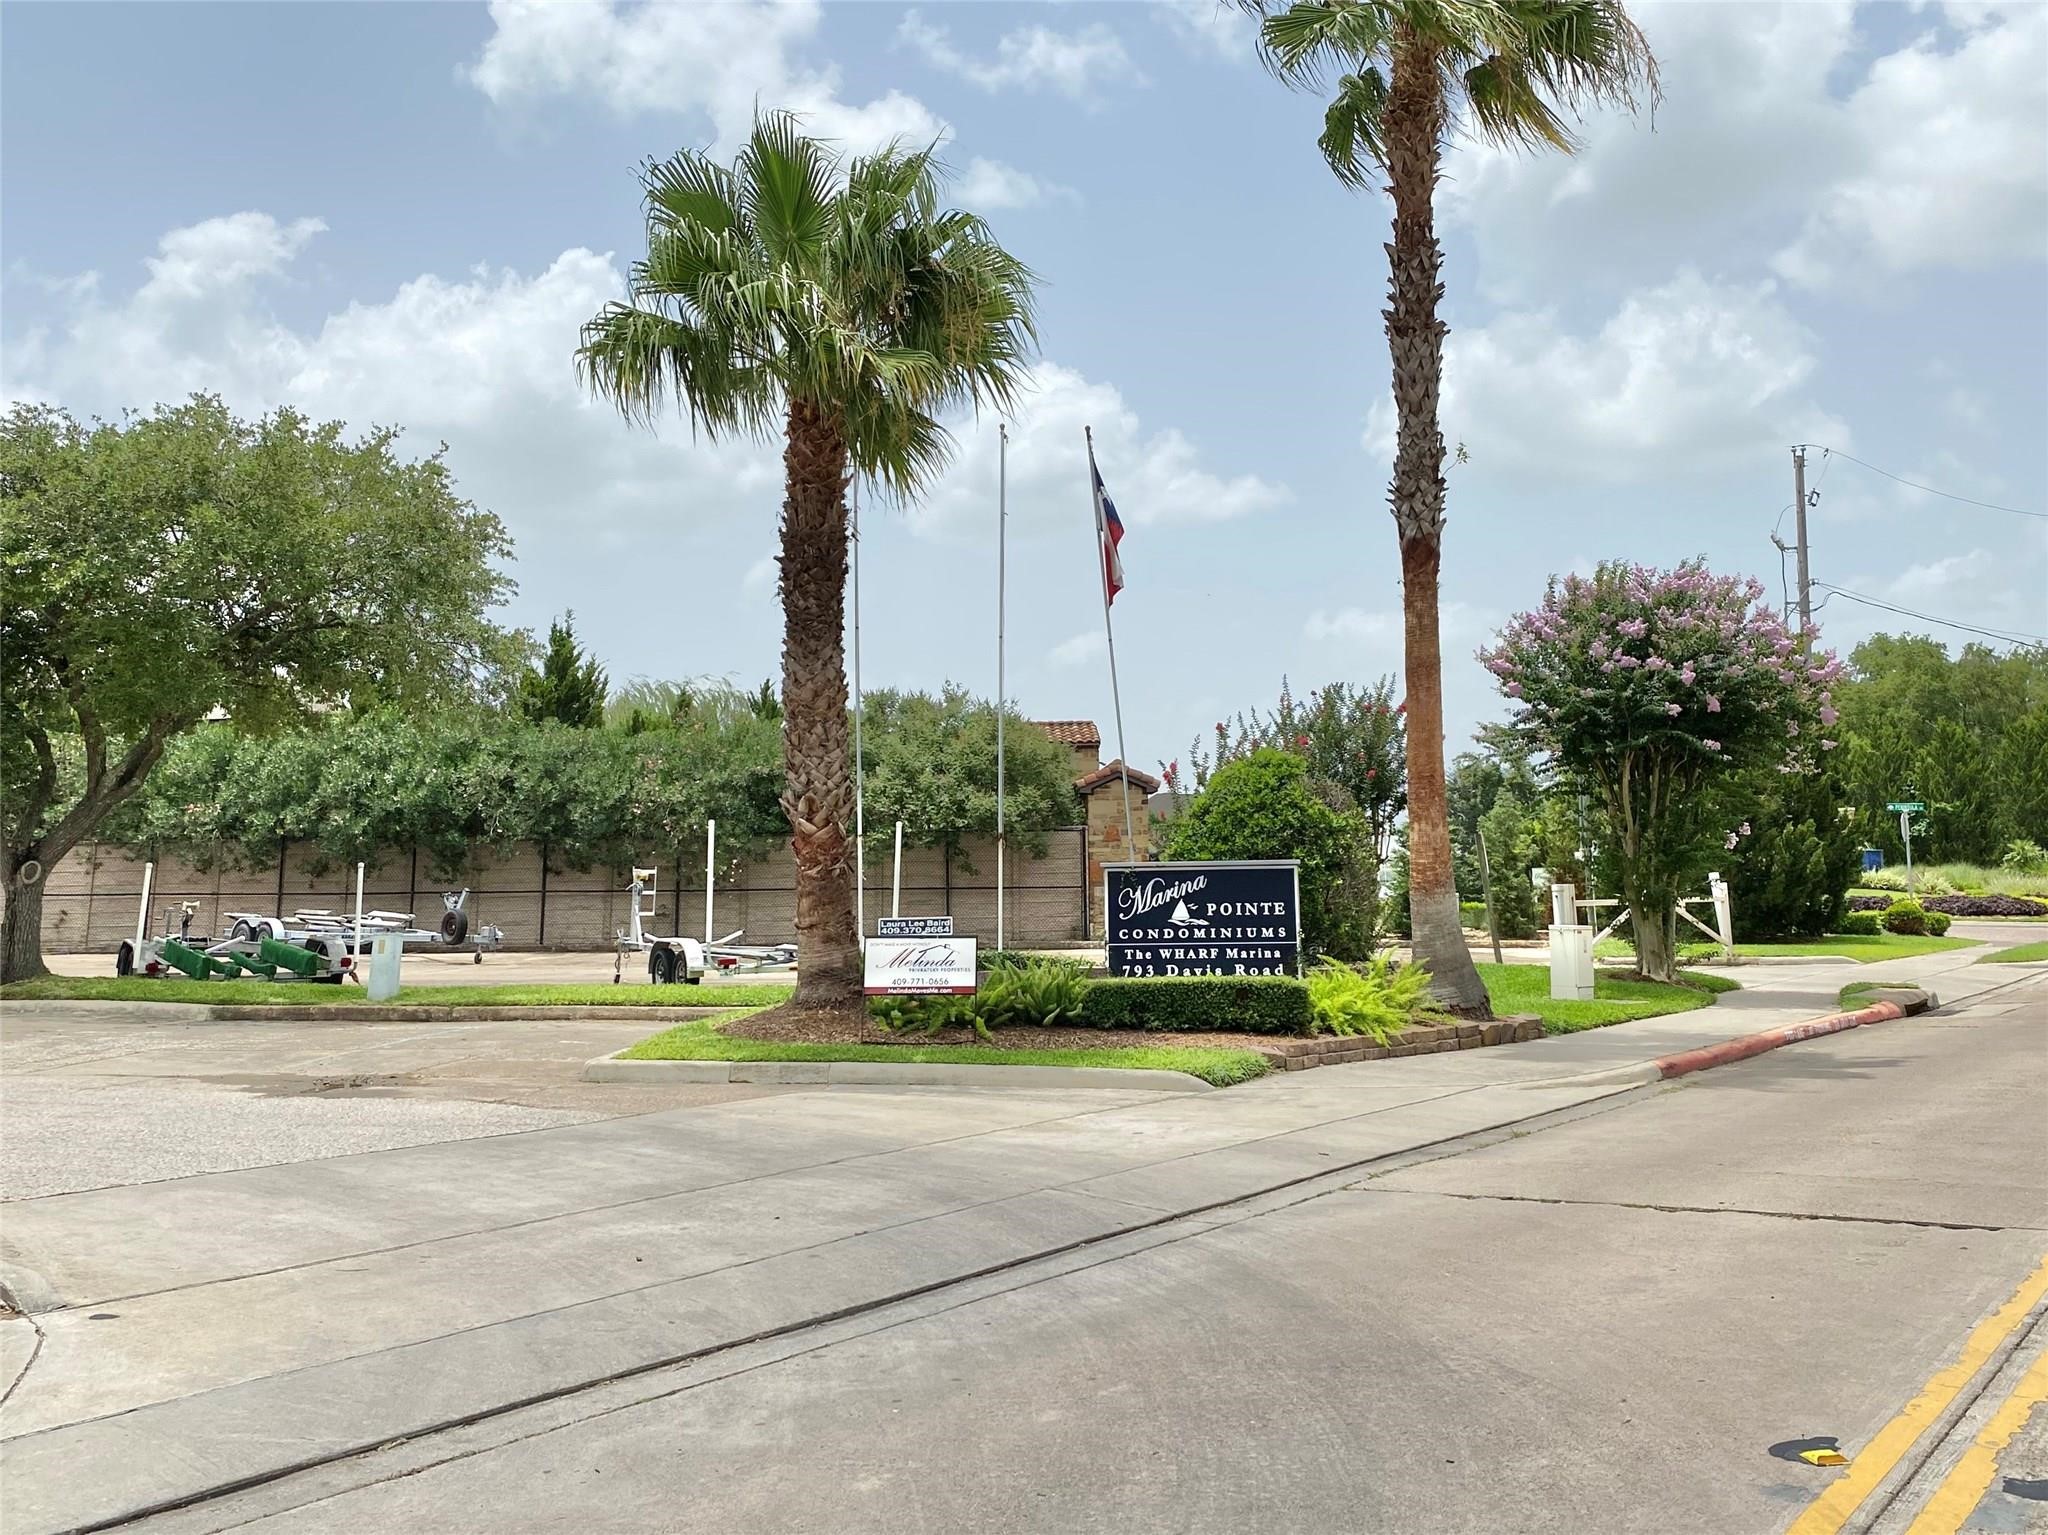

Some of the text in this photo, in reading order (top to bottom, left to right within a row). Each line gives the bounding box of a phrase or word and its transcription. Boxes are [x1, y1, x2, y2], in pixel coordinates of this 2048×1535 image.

[1118, 874, 1208, 920] Marina
[1206, 902, 1286, 916] POINTE
[1118, 927, 1287, 940] CONDOMINIUMS
[875, 945, 958, 969] Melinda
[1124, 947, 1282, 960] The WHARF Marina
[1122, 963, 1285, 978] 793 Davis Road
